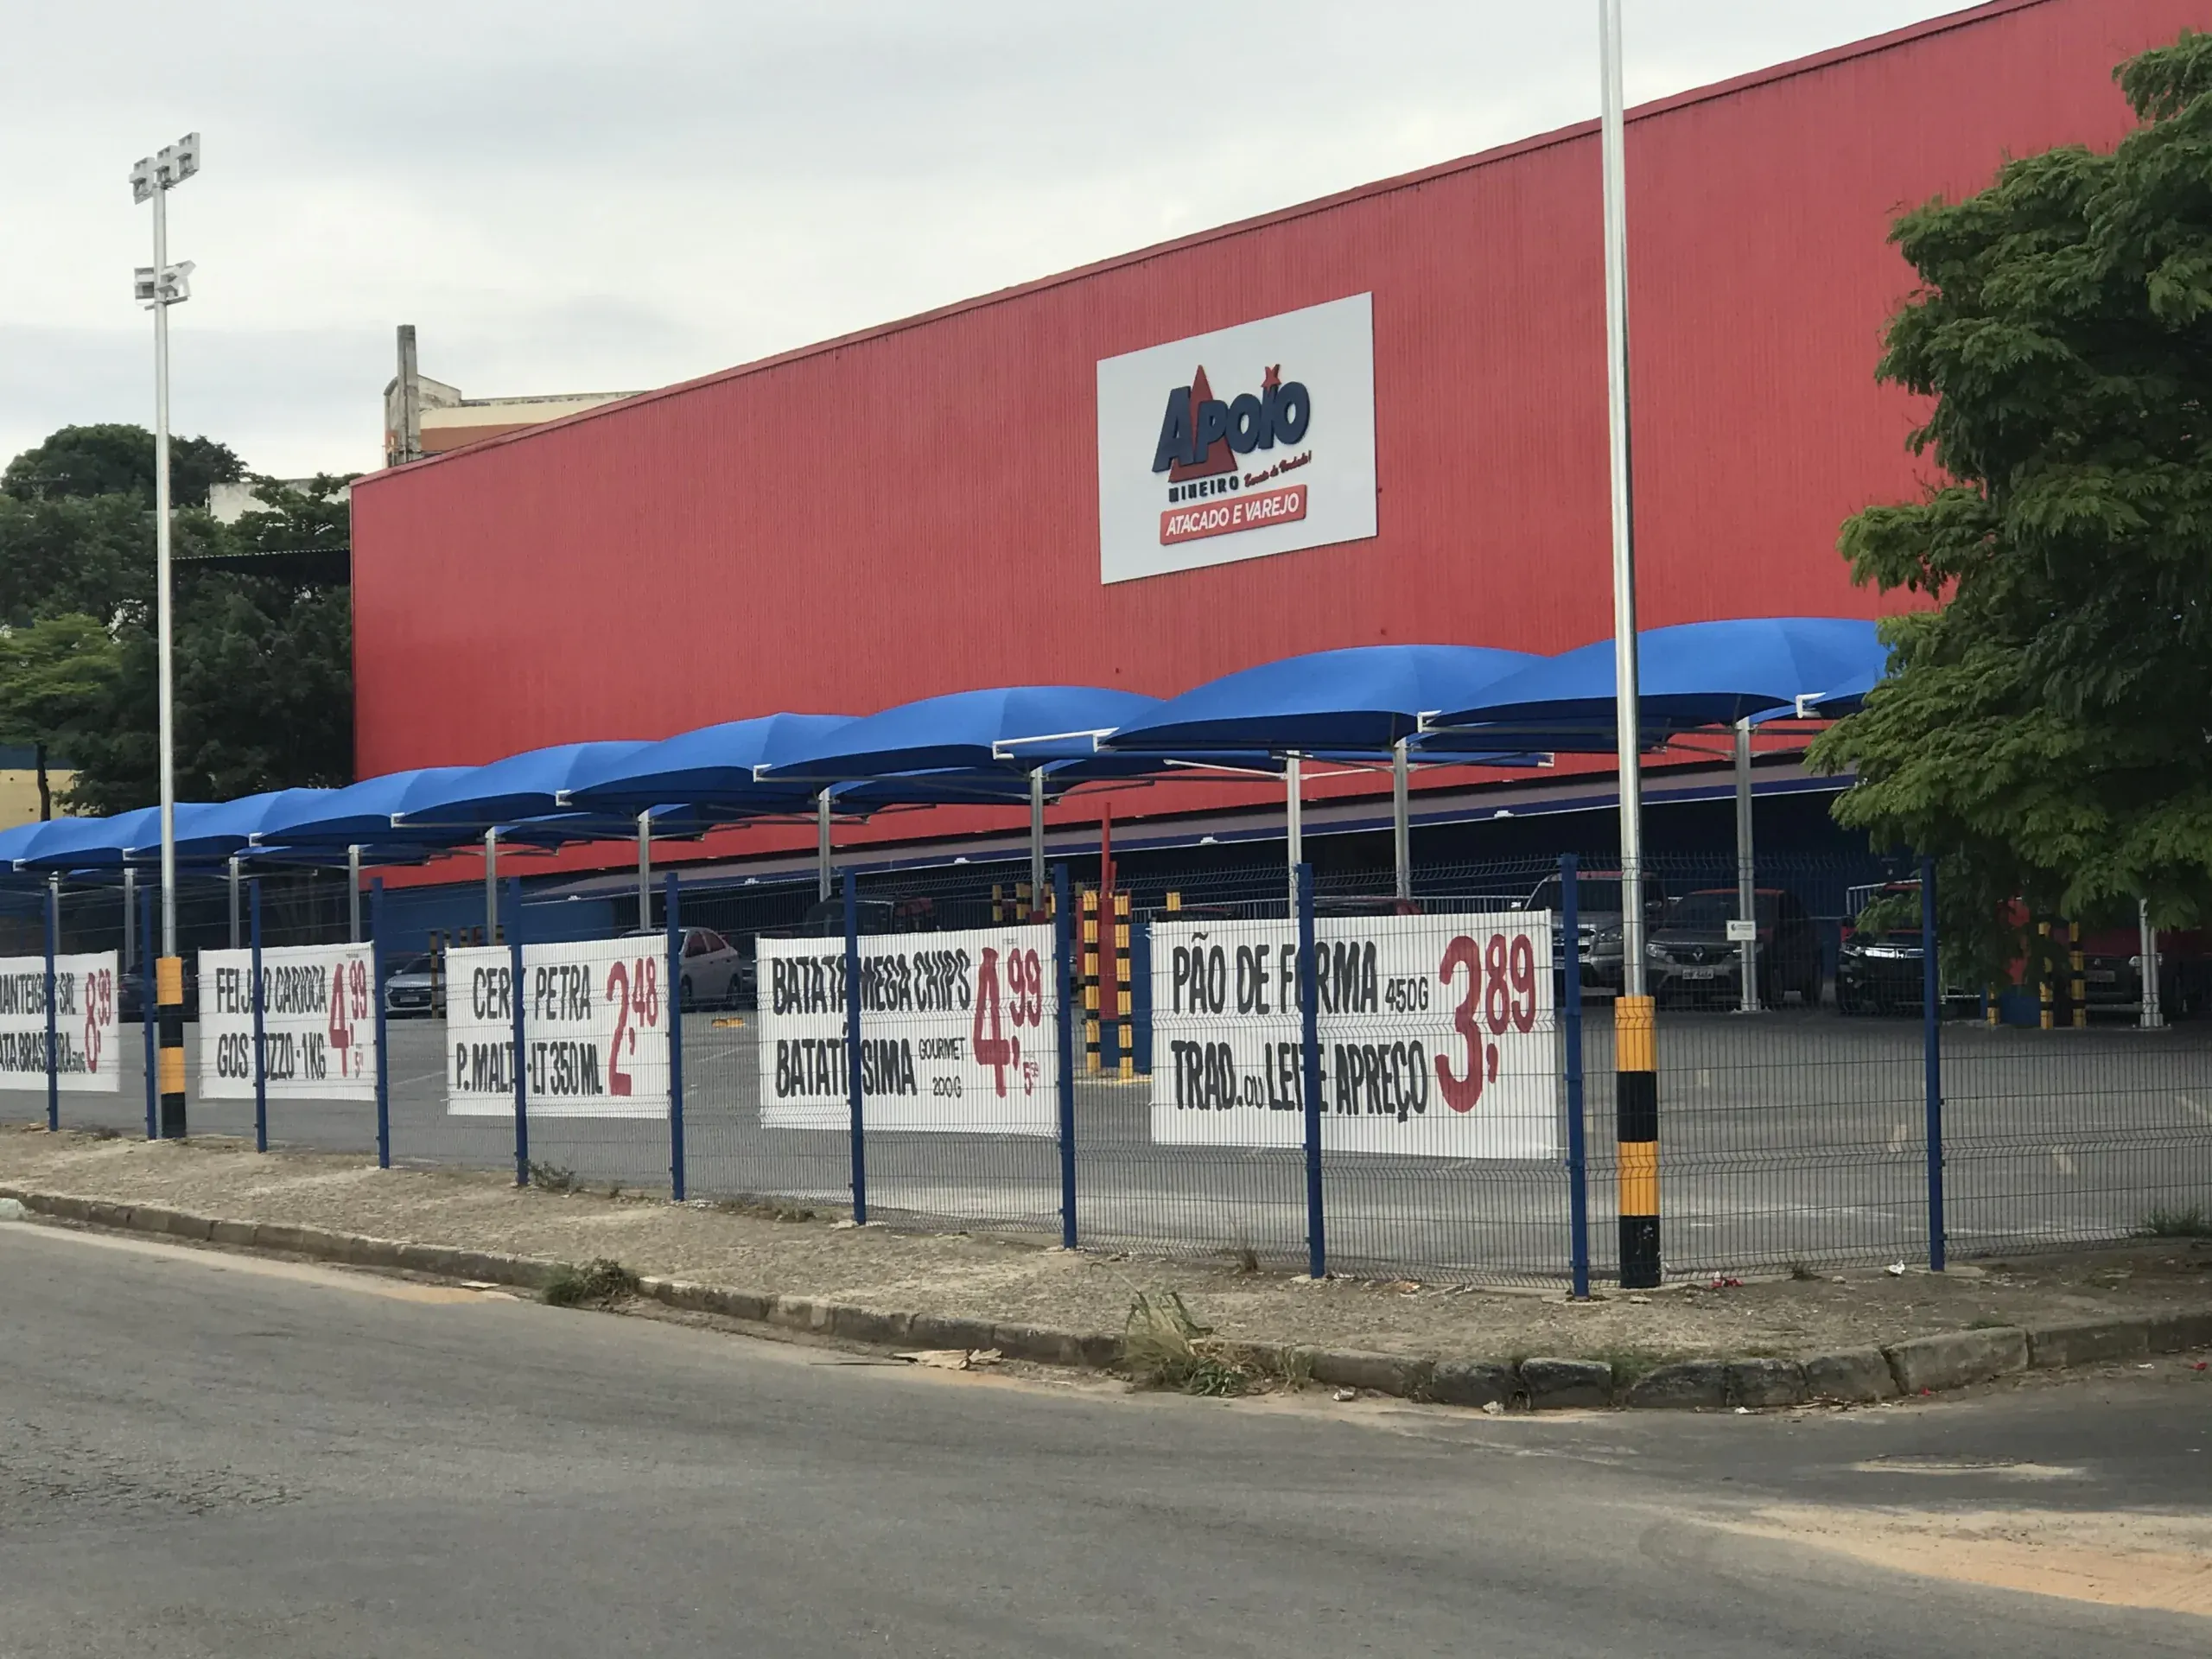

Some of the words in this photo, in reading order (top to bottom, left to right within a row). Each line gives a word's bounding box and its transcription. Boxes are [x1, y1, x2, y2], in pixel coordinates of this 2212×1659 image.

[1166, 506, 1230, 536] ATACADO
[1233, 505, 1242, 524] E
[1245, 493, 1300, 522] VAREJO
[1169, 475, 1239, 503] MINEIRO
[216, 967, 272, 1014] FEIJO
[275, 965, 328, 1014] CARIOCA
[535, 964, 592, 1021] PETRA
[913, 947, 971, 1012] CHIPS
[1173, 932, 1227, 1014] PÃO
[1236, 944, 1270, 1015] DE
[1385, 976, 1429, 1013] 450G
[776, 1022, 918, 1098] BATATÍSIMA
[918, 1036, 965, 1061] GOURMET
[932, 1075, 962, 1098] 200G
